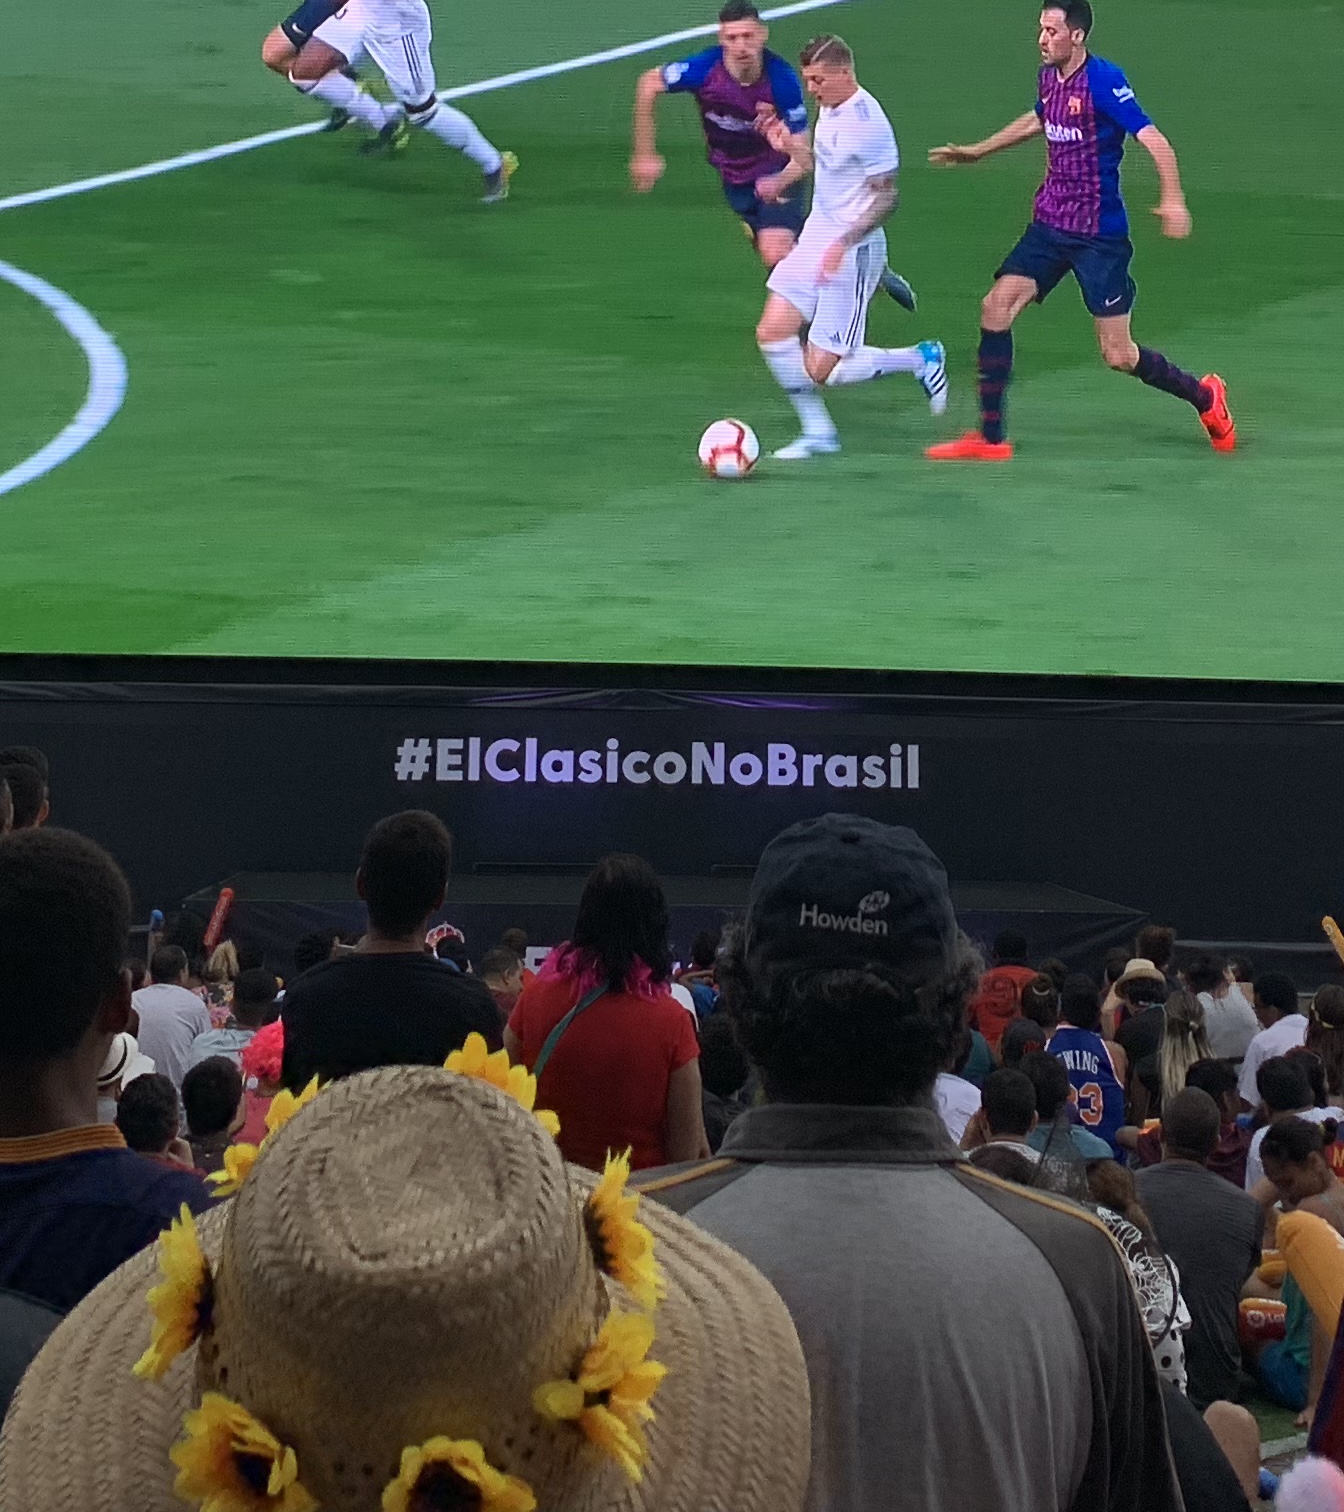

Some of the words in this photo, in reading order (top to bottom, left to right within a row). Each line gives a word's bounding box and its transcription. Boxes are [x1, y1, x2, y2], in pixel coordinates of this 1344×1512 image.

[394, 736, 921, 789] #ElClasicoNoBrasil
[799, 902, 889, 936] Howden
[1056, 1050, 1101, 1076] WING
